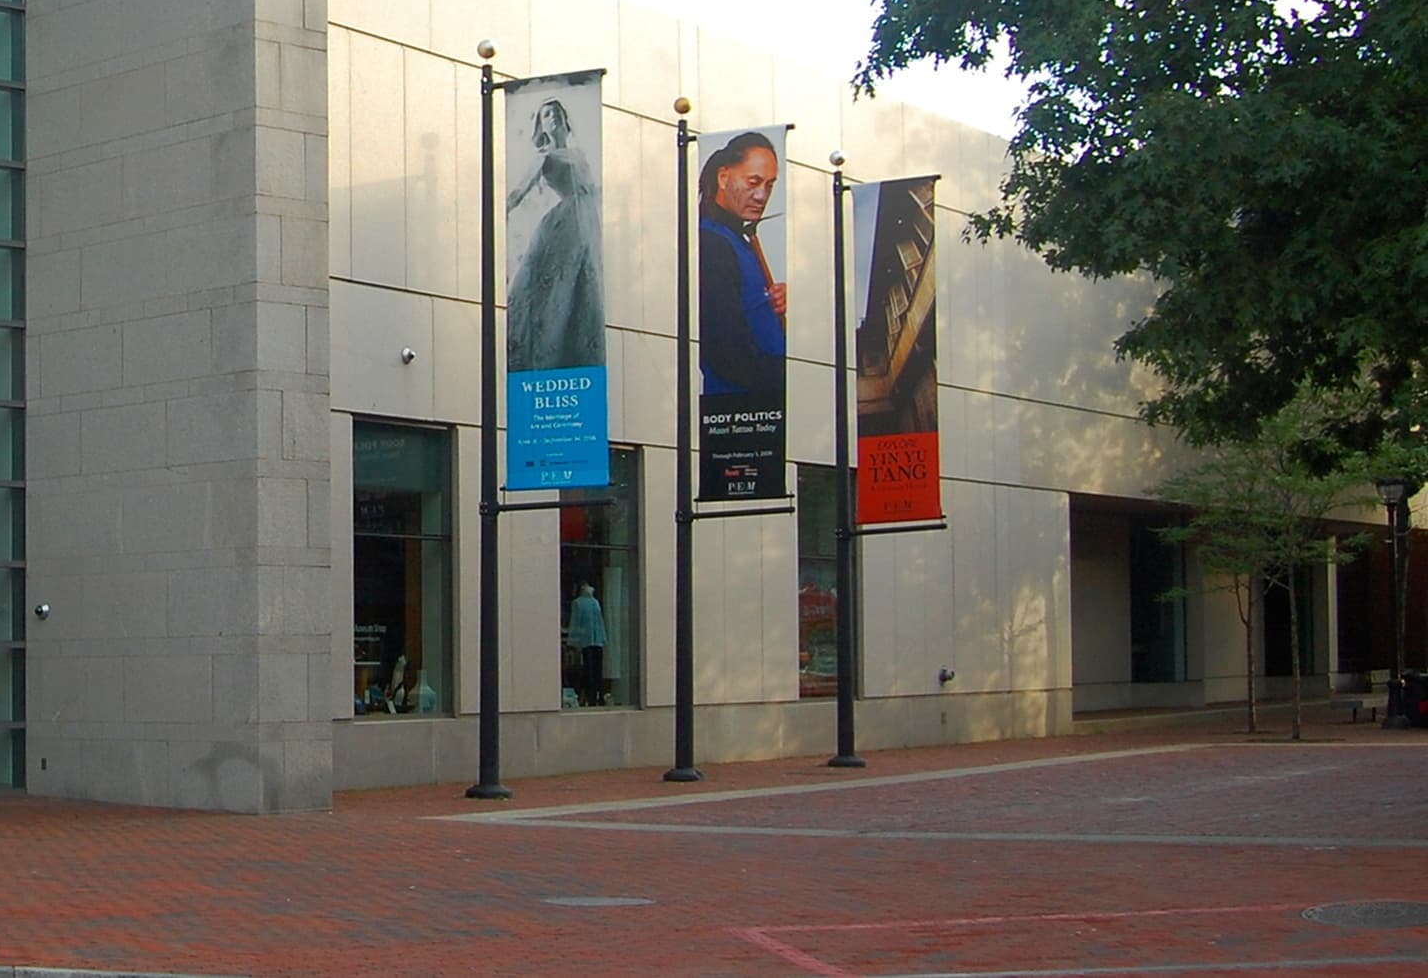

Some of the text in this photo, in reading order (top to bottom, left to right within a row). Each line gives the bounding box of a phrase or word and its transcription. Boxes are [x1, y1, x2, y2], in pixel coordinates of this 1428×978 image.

[522, 377, 591, 393] WEDDED
[534, 395, 579, 409] BLISS
[703, 410, 782, 424] BODY POLITICS
[869, 449, 927, 466] YIN YU
[868, 463, 927, 483] TANG
